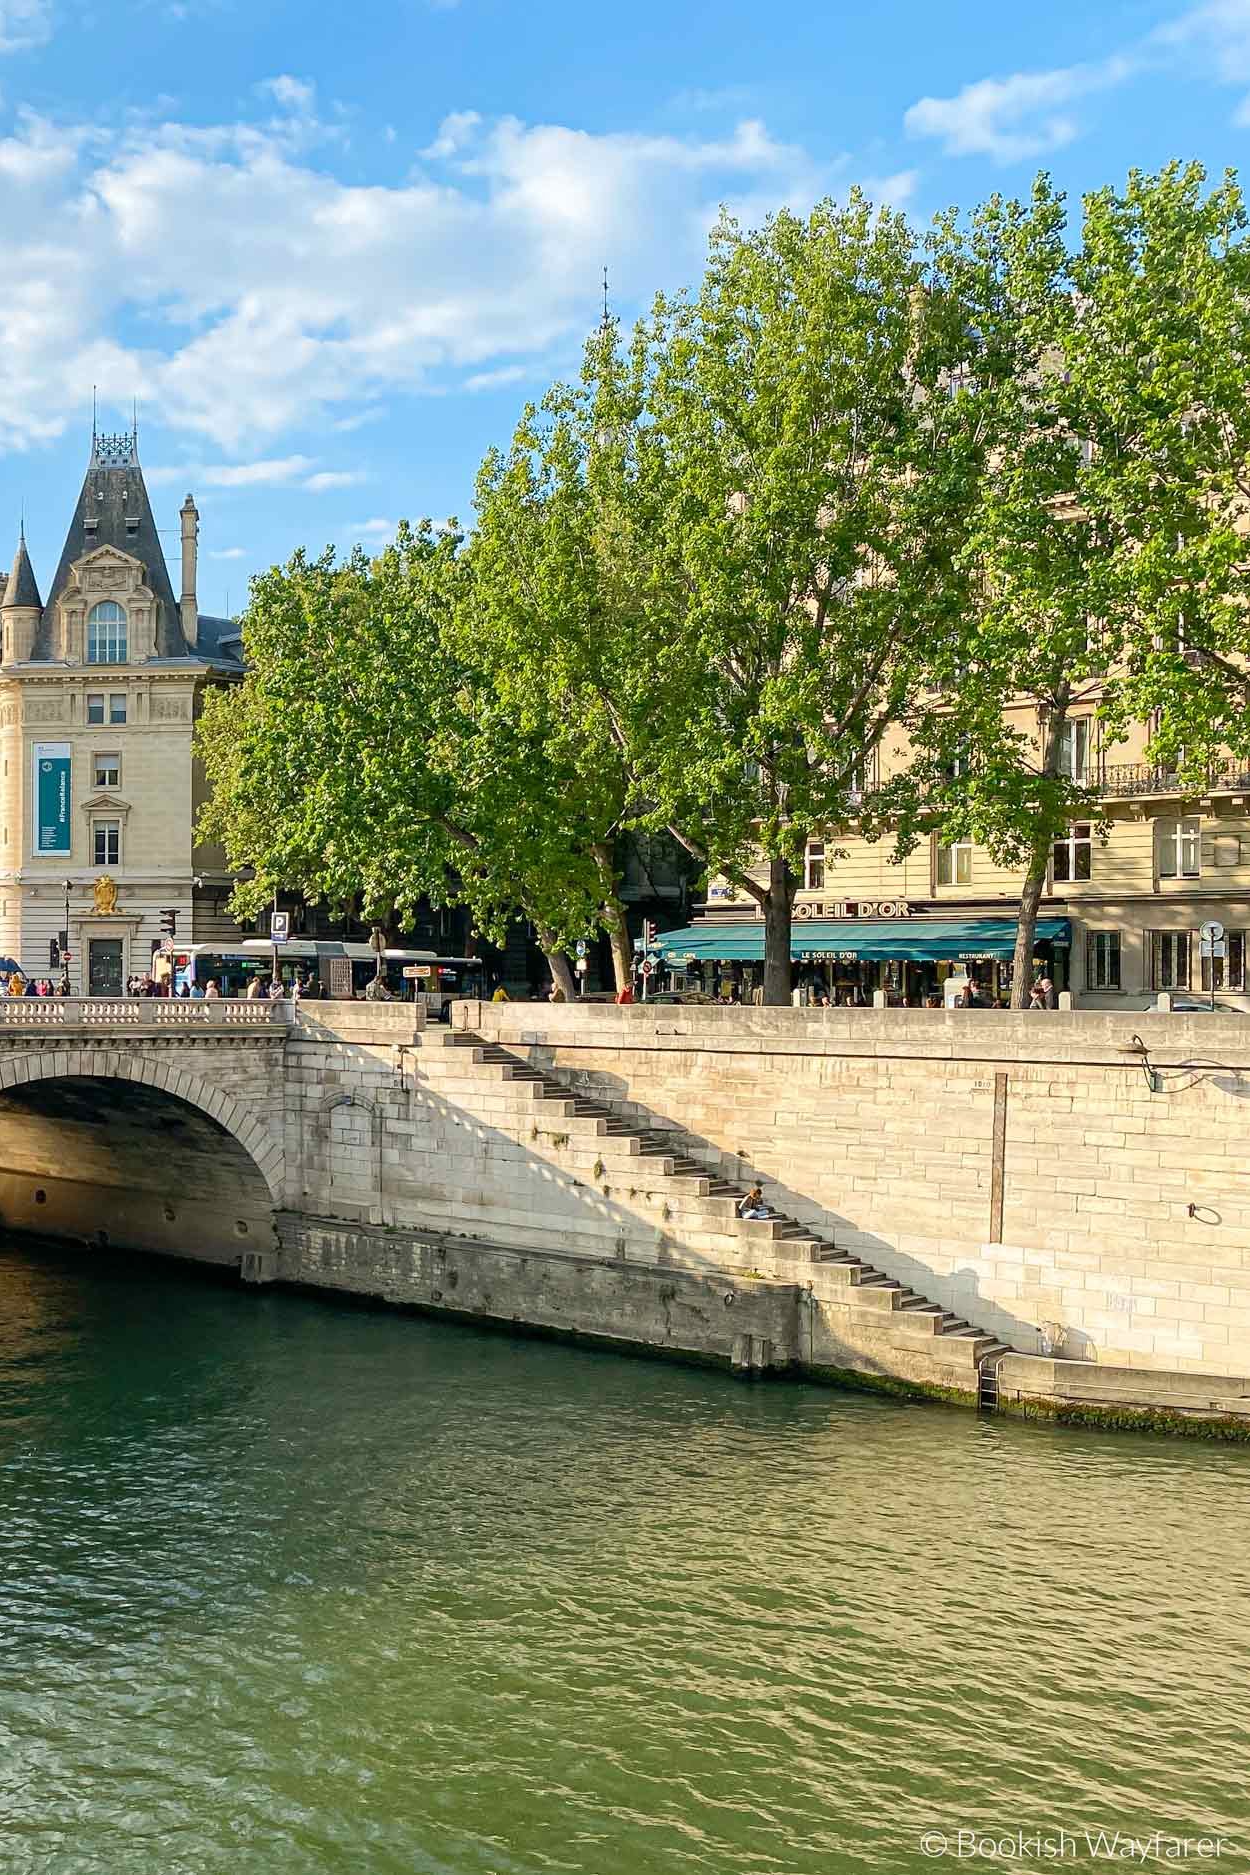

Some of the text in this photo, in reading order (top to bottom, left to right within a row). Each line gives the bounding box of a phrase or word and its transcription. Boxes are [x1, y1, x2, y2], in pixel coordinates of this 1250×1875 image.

[790, 903, 854, 919] SOLEIL
[857, 902, 910, 918] D'OR
[275, 916, 284, 930] P
[801, 951, 857, 959] LE SOLEIL D'OR
